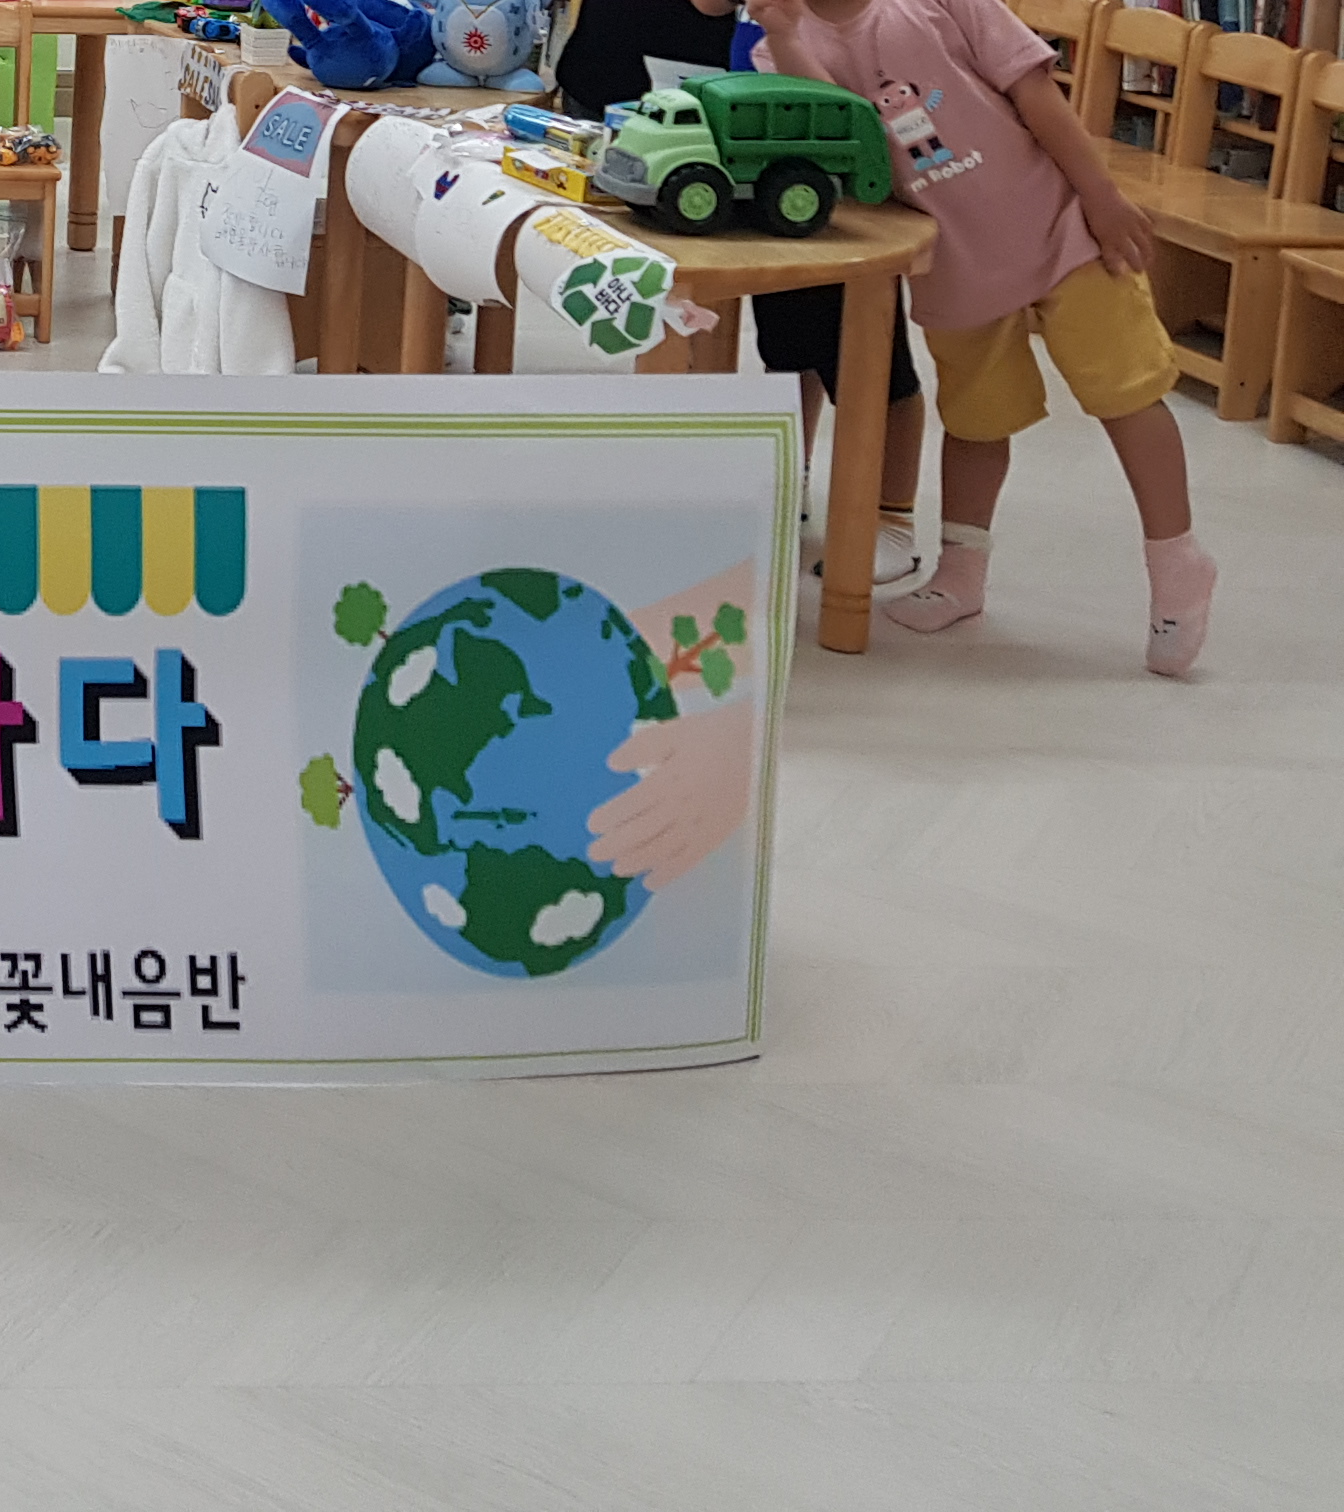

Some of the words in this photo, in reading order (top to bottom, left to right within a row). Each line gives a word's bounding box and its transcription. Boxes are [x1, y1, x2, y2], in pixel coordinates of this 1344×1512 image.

[262, 112, 313, 153] SALE
[928, 149, 983, 182] Robot
[595, 290, 620, 316] 바다
[608, 278, 632, 303] 아나
